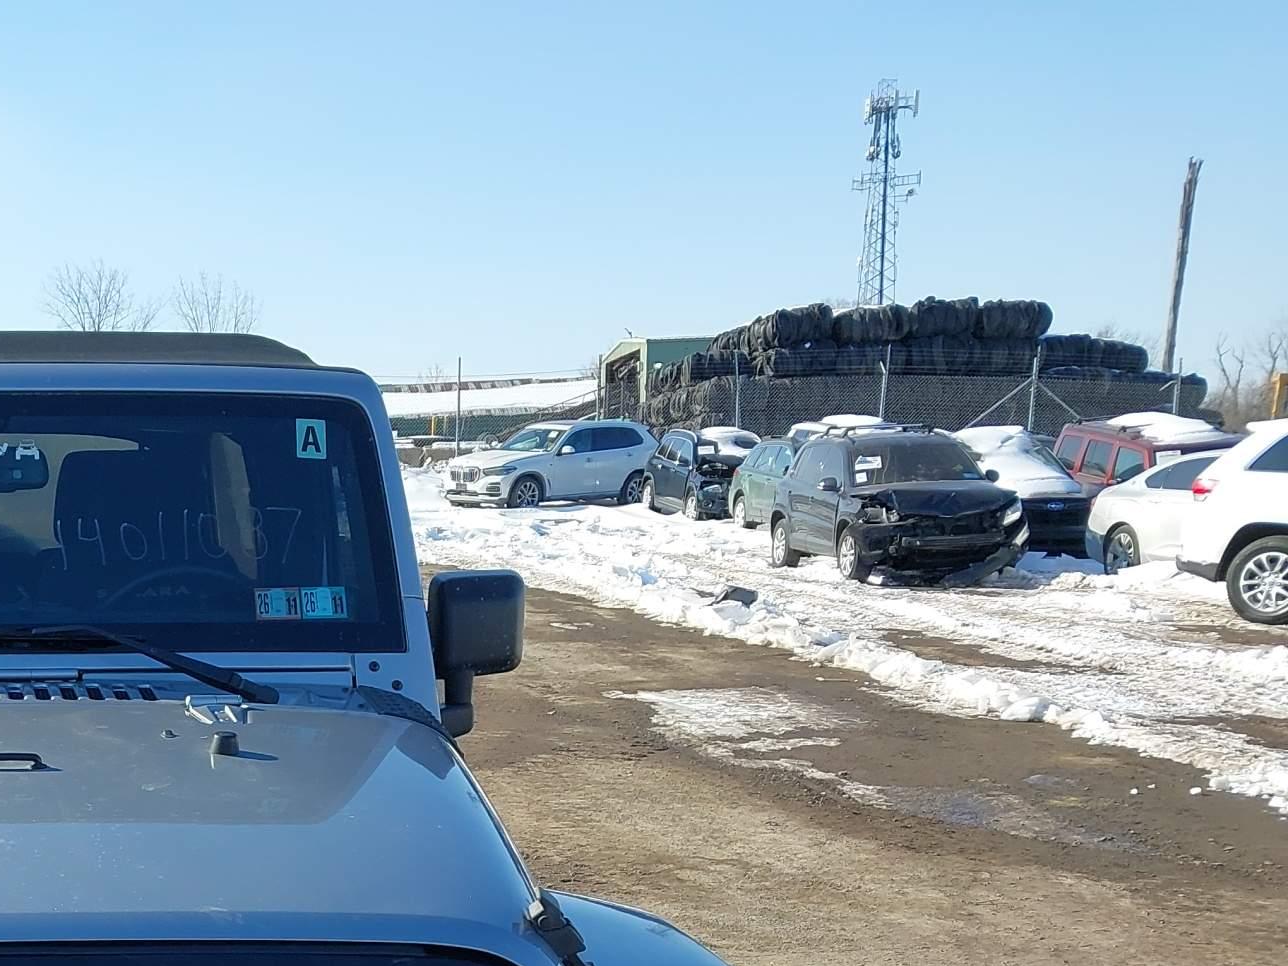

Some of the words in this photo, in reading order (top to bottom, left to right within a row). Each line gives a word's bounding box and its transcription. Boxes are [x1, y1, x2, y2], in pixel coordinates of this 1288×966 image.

[301, 425, 322, 453] A
[257, 592, 270, 615] 26
[303, 591, 316, 614] 26
